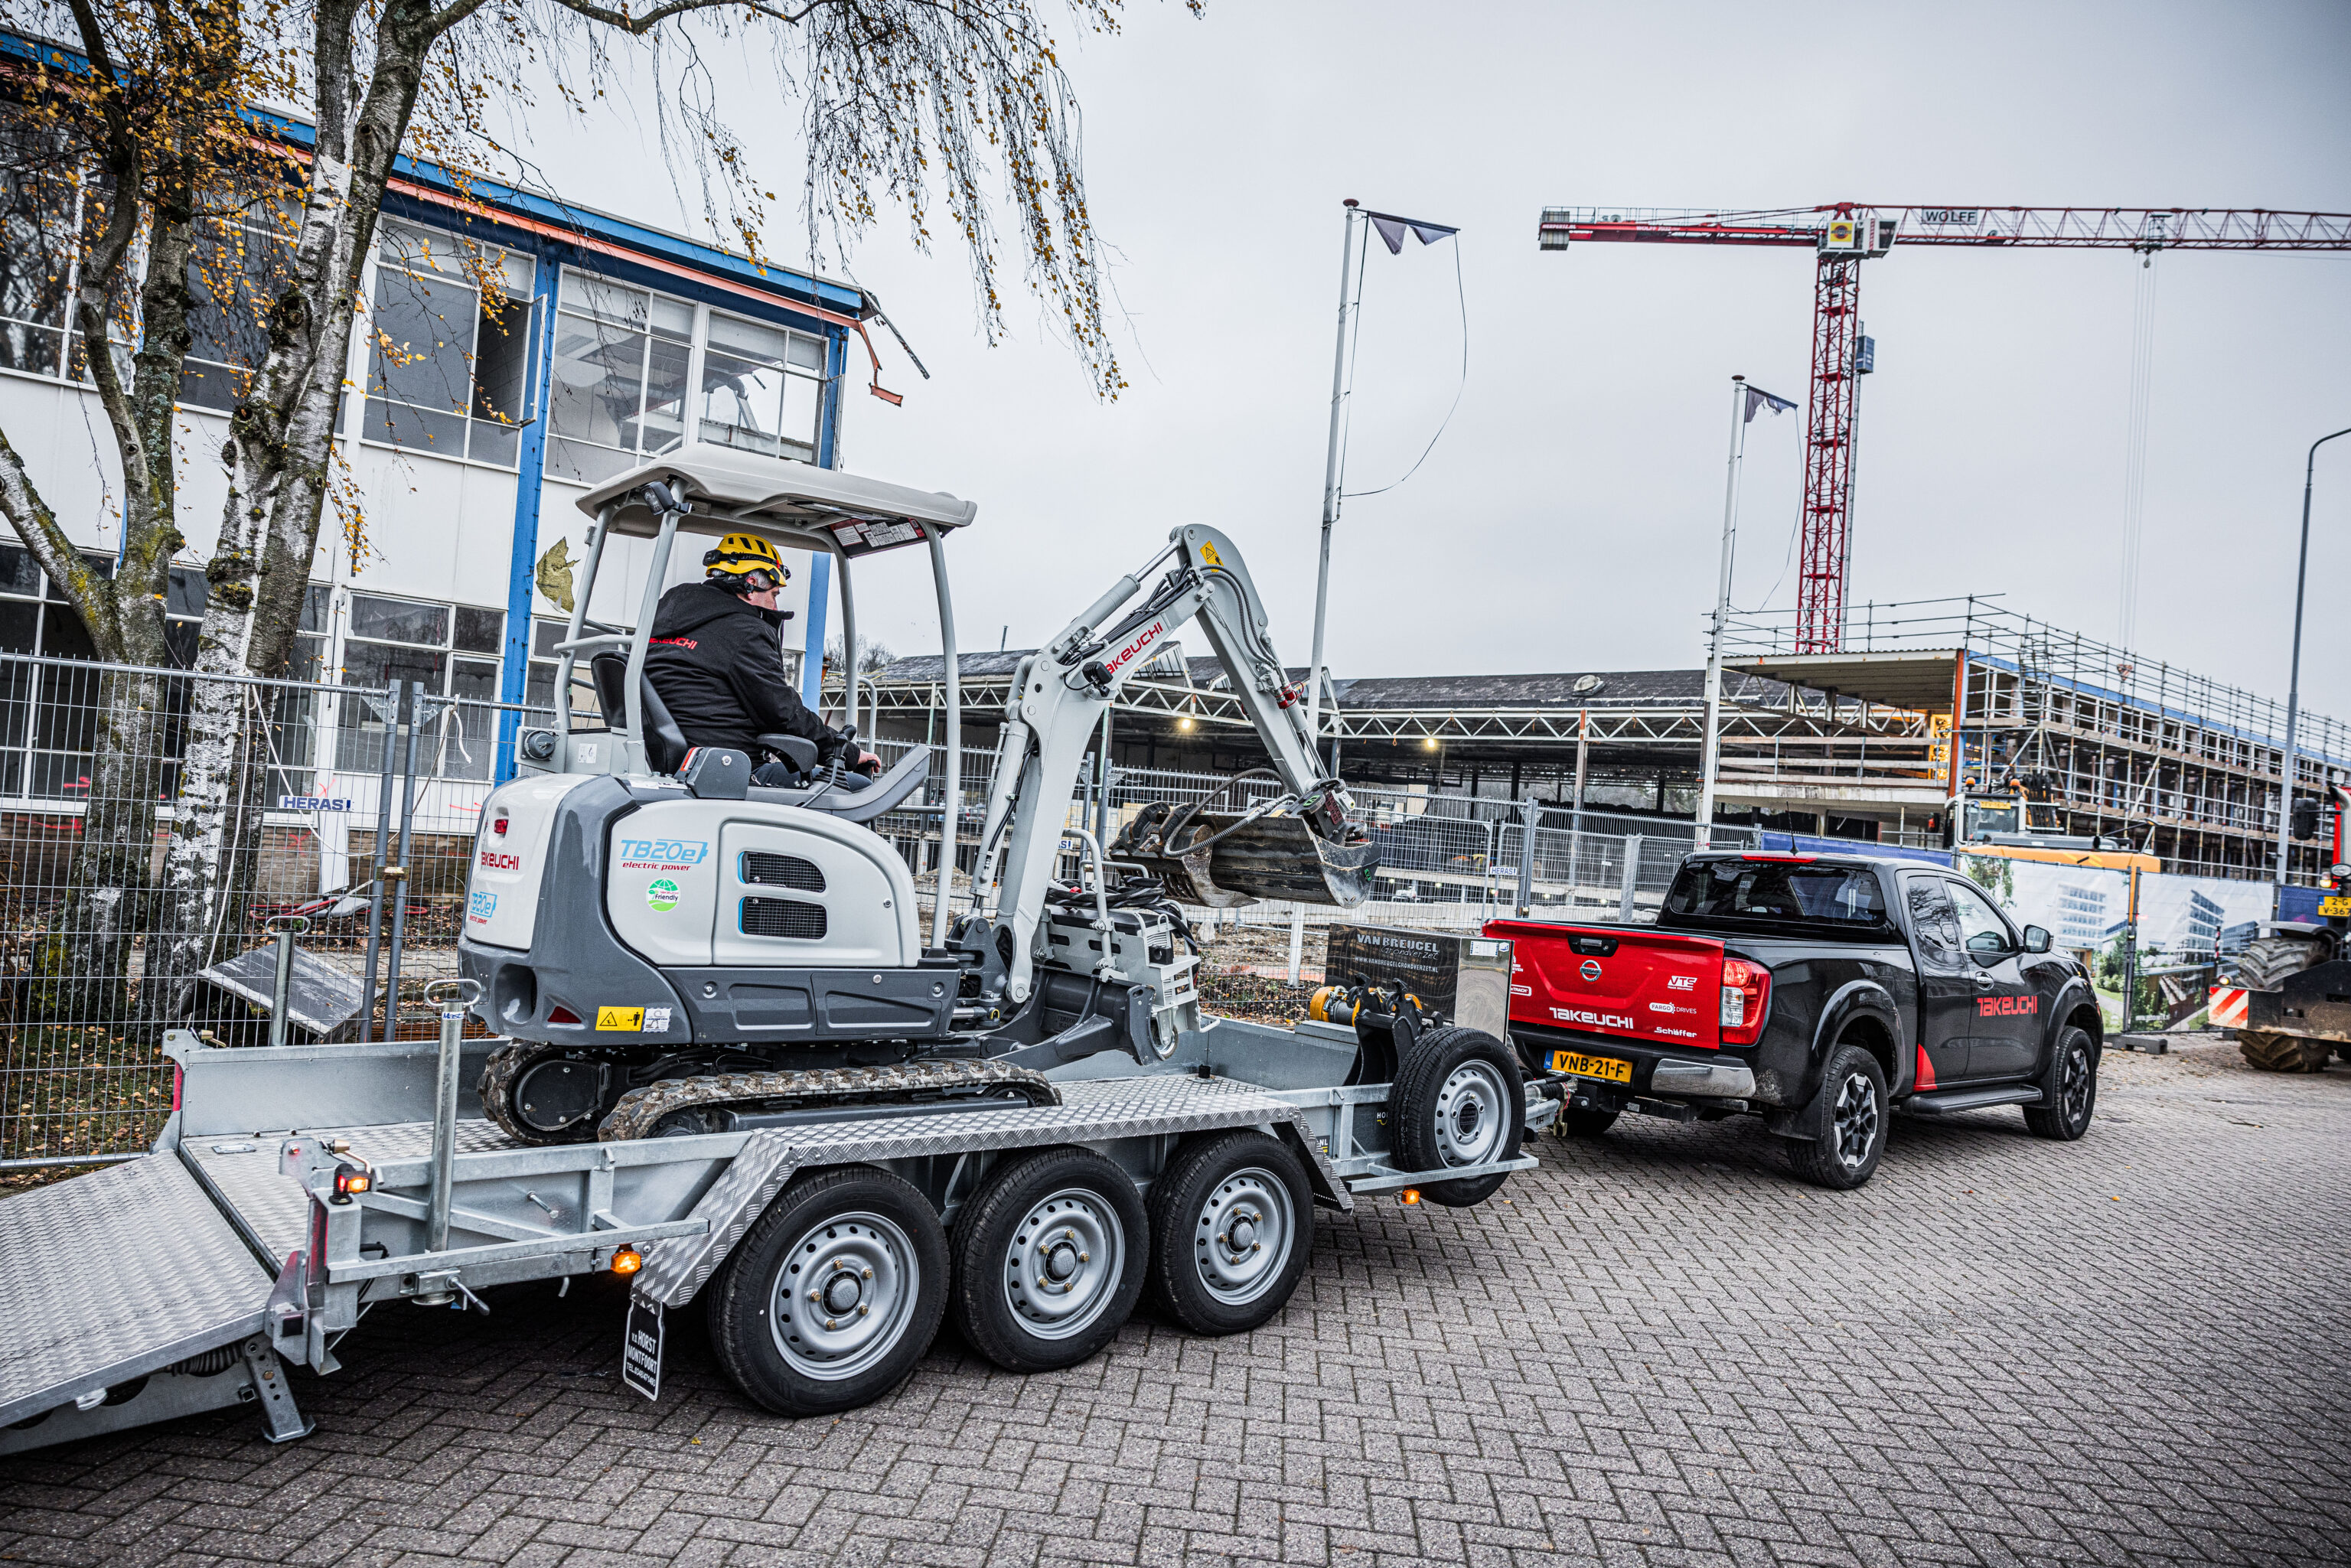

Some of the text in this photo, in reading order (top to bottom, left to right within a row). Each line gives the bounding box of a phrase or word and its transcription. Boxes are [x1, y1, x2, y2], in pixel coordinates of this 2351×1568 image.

[1925, 210, 1978, 223] WOLFF
[1105, 621, 1163, 674] AKEUCHI
[621, 839, 697, 862] TB20e
[622, 862, 659, 870] electric
[654, 894, 679, 902] Friendly
[1357, 934, 1440, 953] VAN BREUGEL
[1381, 944, 1439, 960] Grondverzet
[1355, 956, 1439, 973] WWW.VANBREUGELGRONDVERZET.NL
[1671, 976, 1696, 986] VTS
[1676, 1006, 1697, 1015] DRIVES
[1654, 1026, 1697, 1038] Schäffer
[1560, 1055, 1625, 1077] VNB-21-F
[637, 1329, 657, 1354] HORST
[628, 1345, 657, 1374] MONTFOORT
